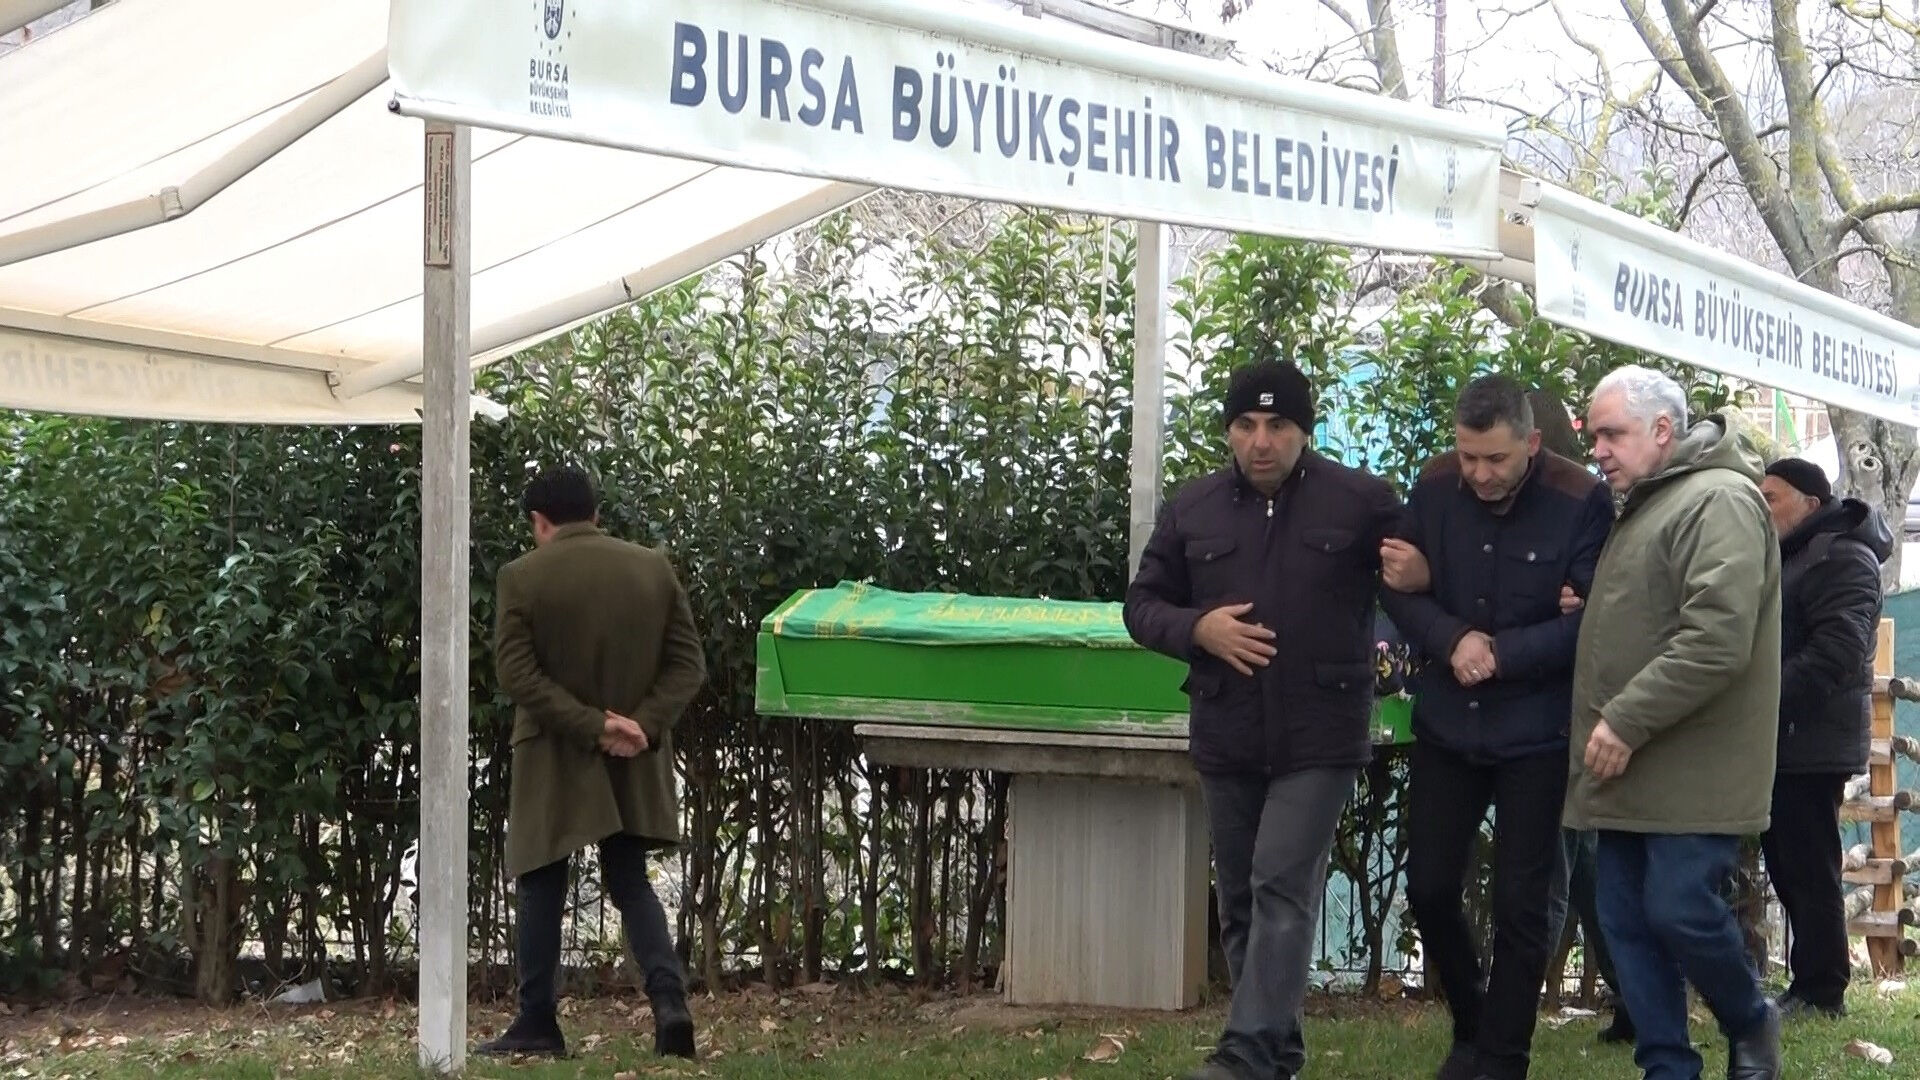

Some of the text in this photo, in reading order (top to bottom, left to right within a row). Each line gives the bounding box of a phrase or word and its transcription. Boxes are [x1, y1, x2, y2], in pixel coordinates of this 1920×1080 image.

[529, 59, 569, 84] BURSA
[670, 21, 1399, 215] BURSA BÜYÜKŞEHİR BELEDİYESİ
[1614, 262, 1684, 332] BURSA
[1695, 280, 1803, 369] BÜYÜKŞEHİR
[1812, 331, 1897, 397] BELEDİYESİ
